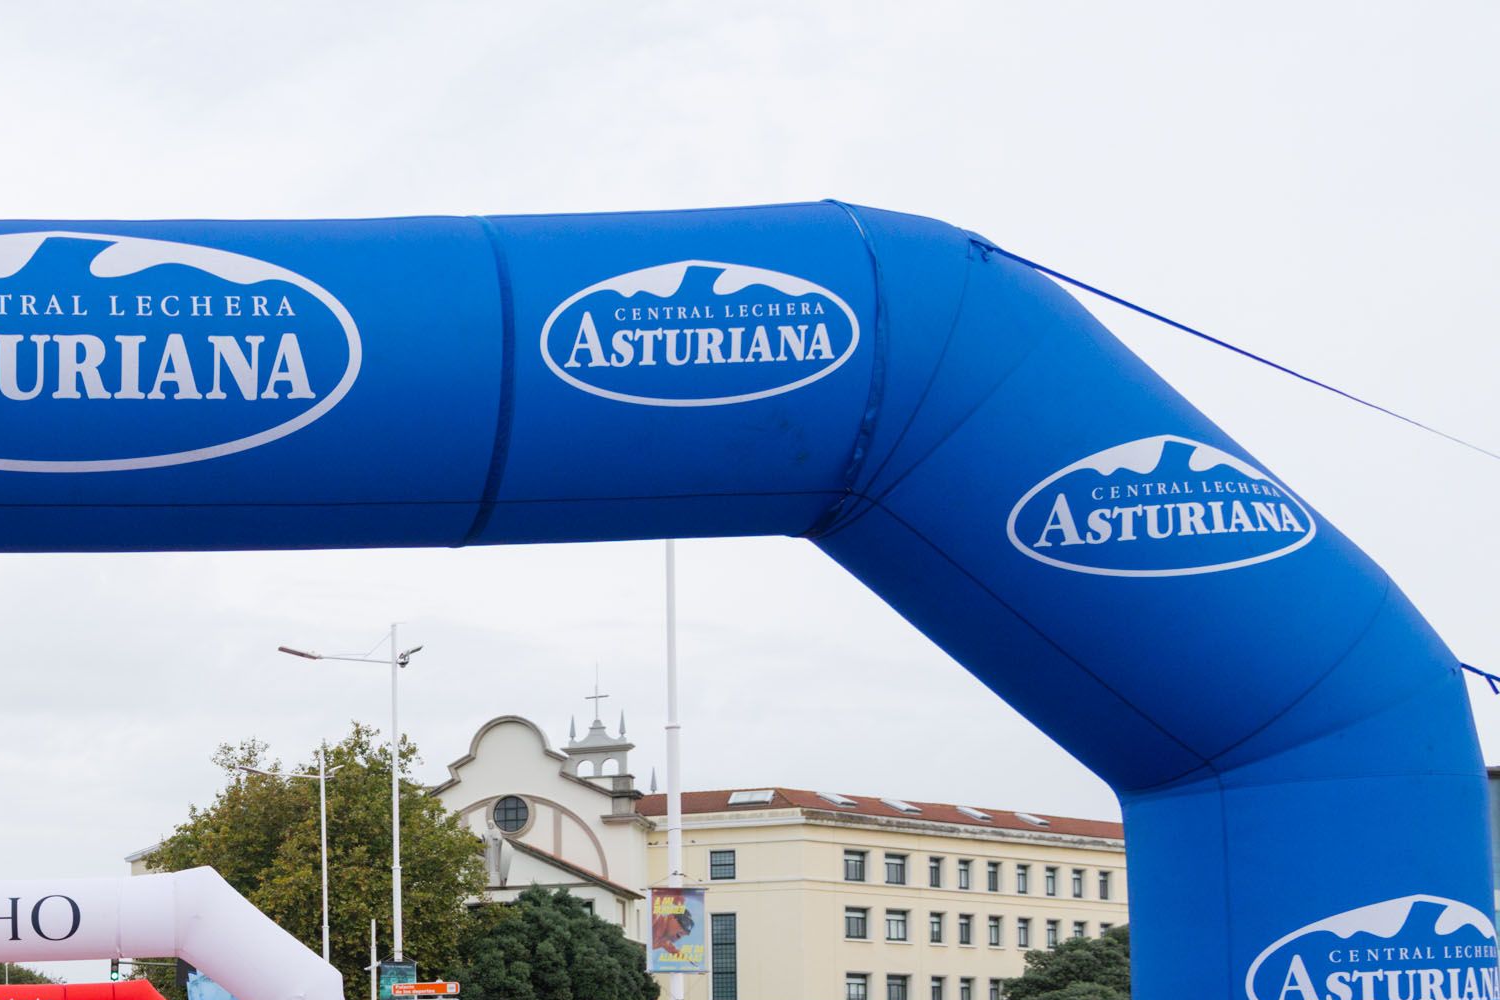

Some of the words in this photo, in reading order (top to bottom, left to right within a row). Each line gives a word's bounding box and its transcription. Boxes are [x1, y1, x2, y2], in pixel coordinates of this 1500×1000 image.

[109, 293, 297, 318] LECHERA
[614, 305, 714, 321] CENTRAL
[725, 303, 825, 318] LECHERA
[563, 311, 836, 368] ASTURIANA
[1091, 481, 1194, 501] CENTRAL
[1202, 480, 1281, 498] LECHERA
[1033, 493, 1306, 548] ASTURIANA
[1329, 945, 1436, 964] CENTRAL
[1444, 944, 1498, 959] LECHER
